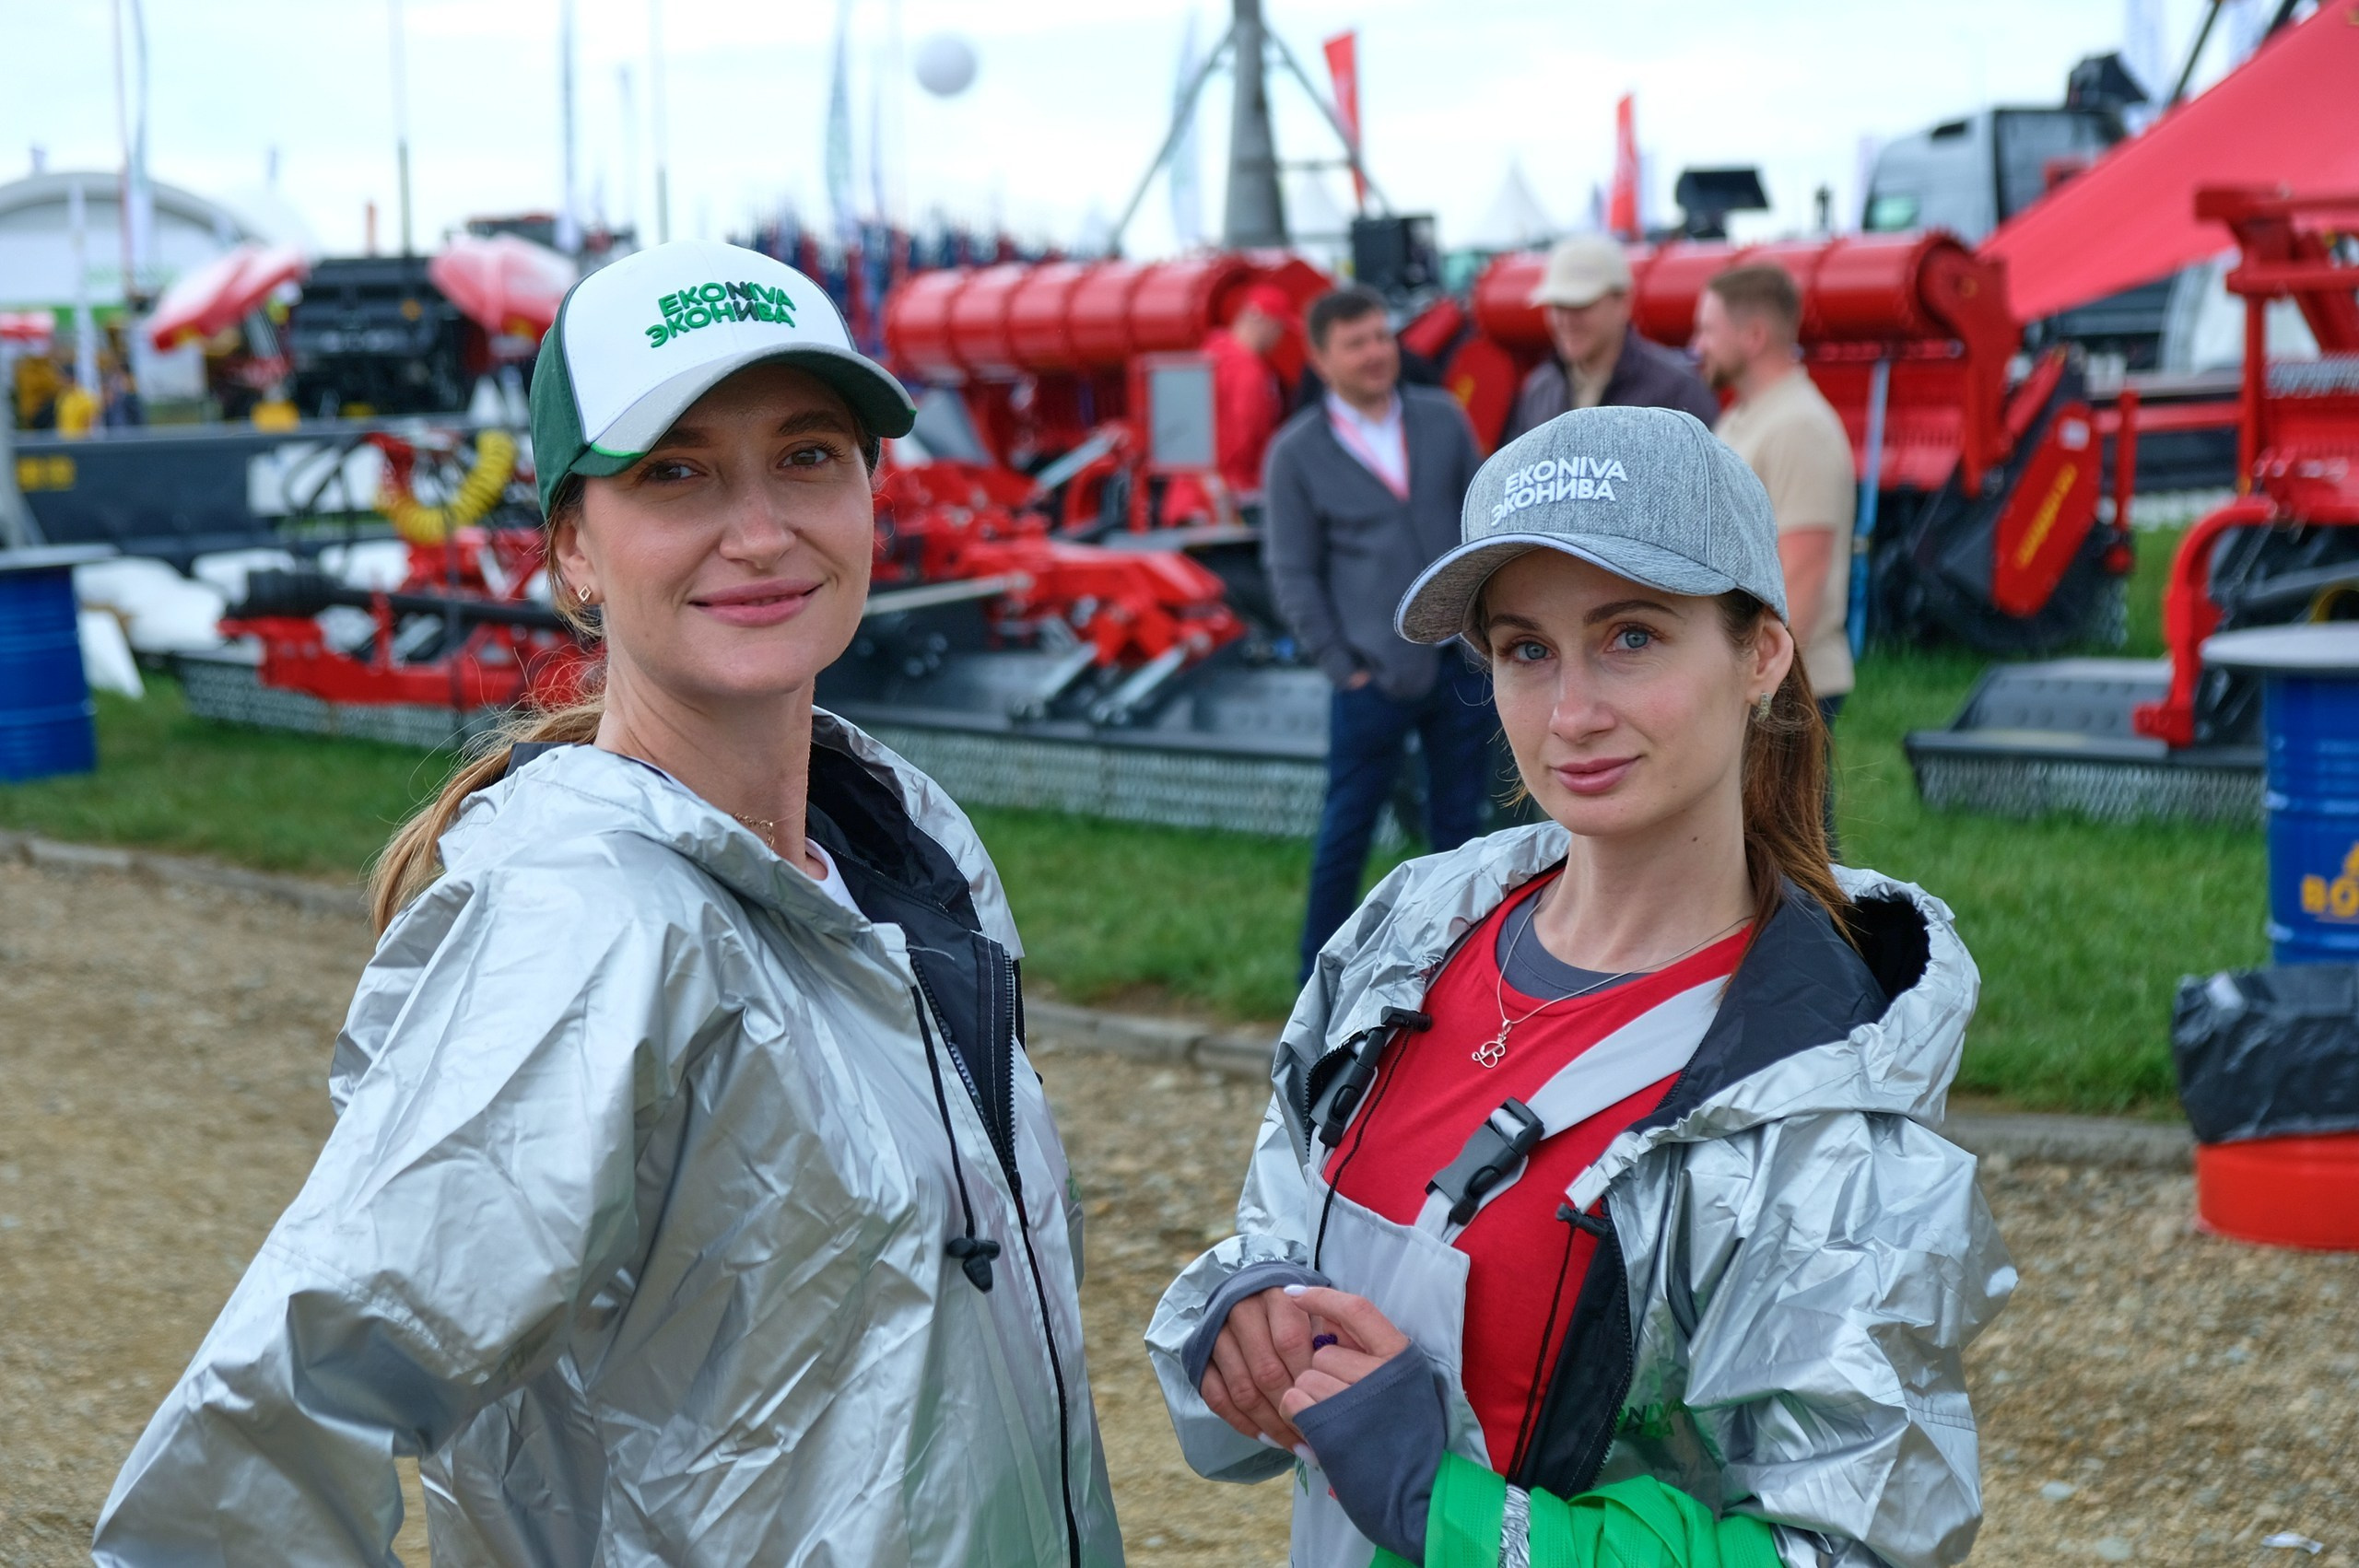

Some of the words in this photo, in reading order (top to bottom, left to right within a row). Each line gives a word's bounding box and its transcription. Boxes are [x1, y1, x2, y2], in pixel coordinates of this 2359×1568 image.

[658, 281, 796, 318] EKONIVA
[645, 300, 796, 348] ЭКОНИВА
[1505, 456, 1628, 497] EKONIVA
[1491, 478, 1616, 527] ЭКОНИВА
